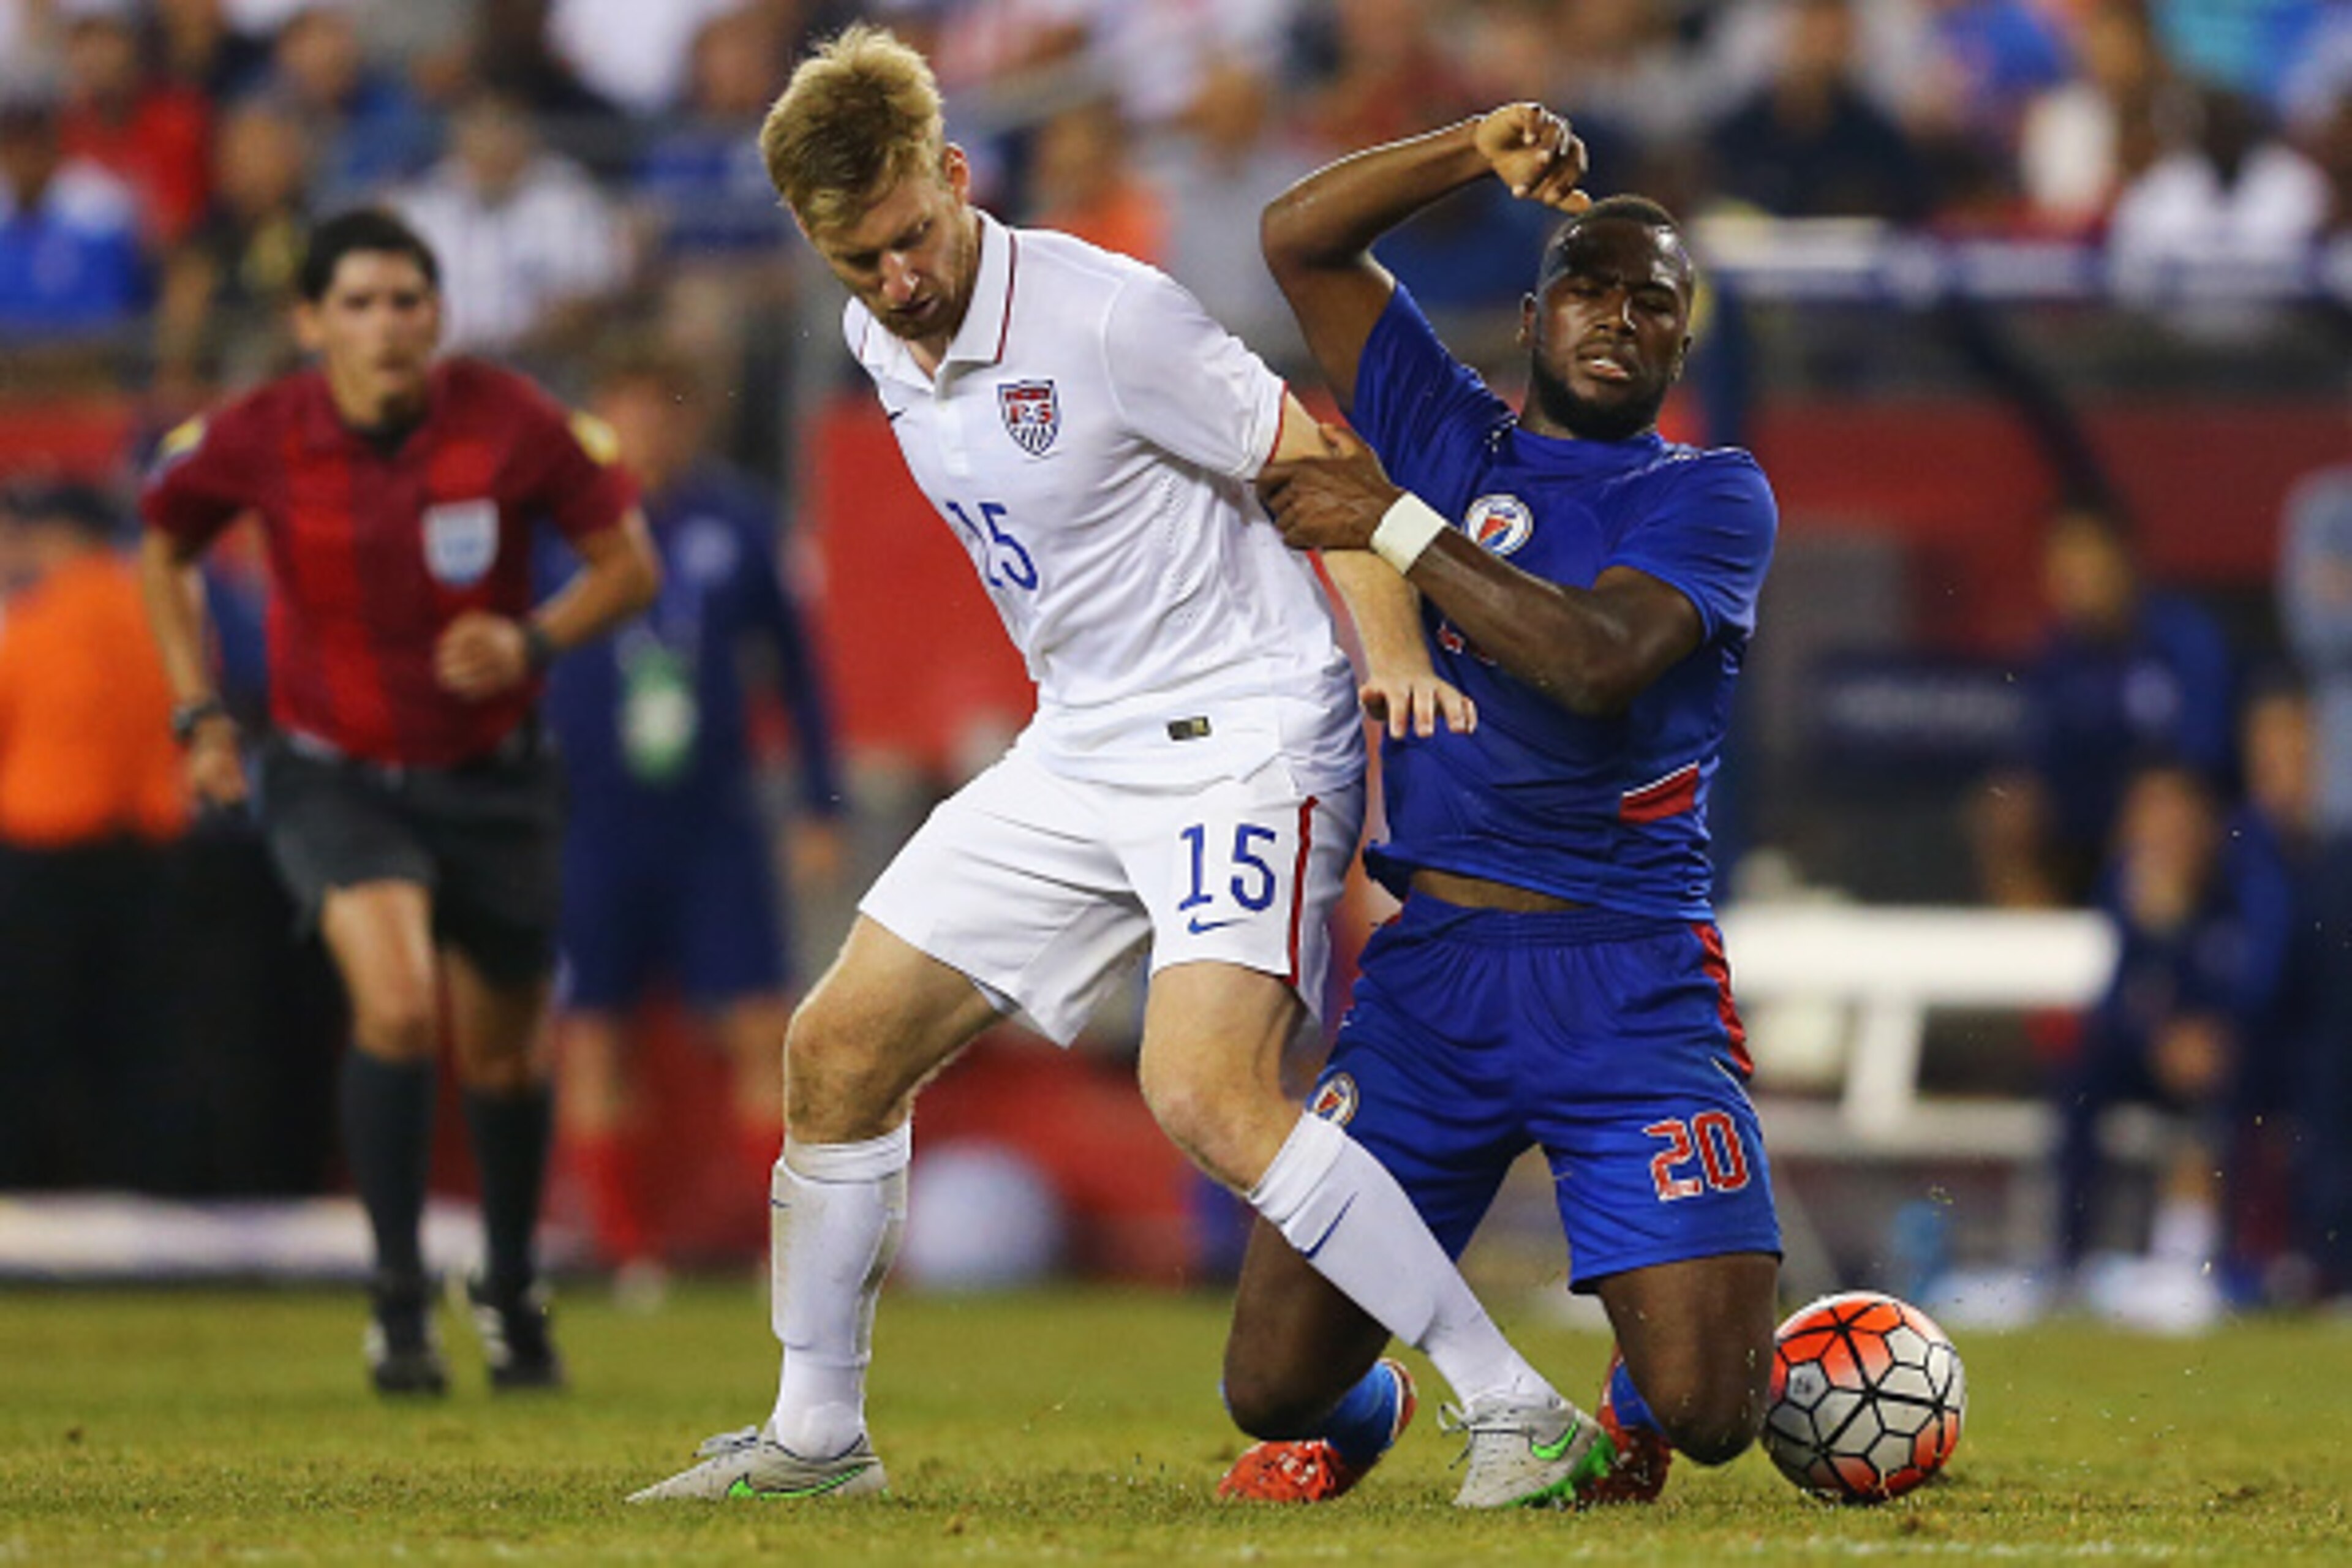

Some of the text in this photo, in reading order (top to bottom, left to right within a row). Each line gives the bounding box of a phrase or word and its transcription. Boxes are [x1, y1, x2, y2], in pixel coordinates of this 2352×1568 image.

[945, 501, 1038, 590] 15
[1178, 823, 1276, 911] 15
[1643, 1110, 1749, 1201] 20
